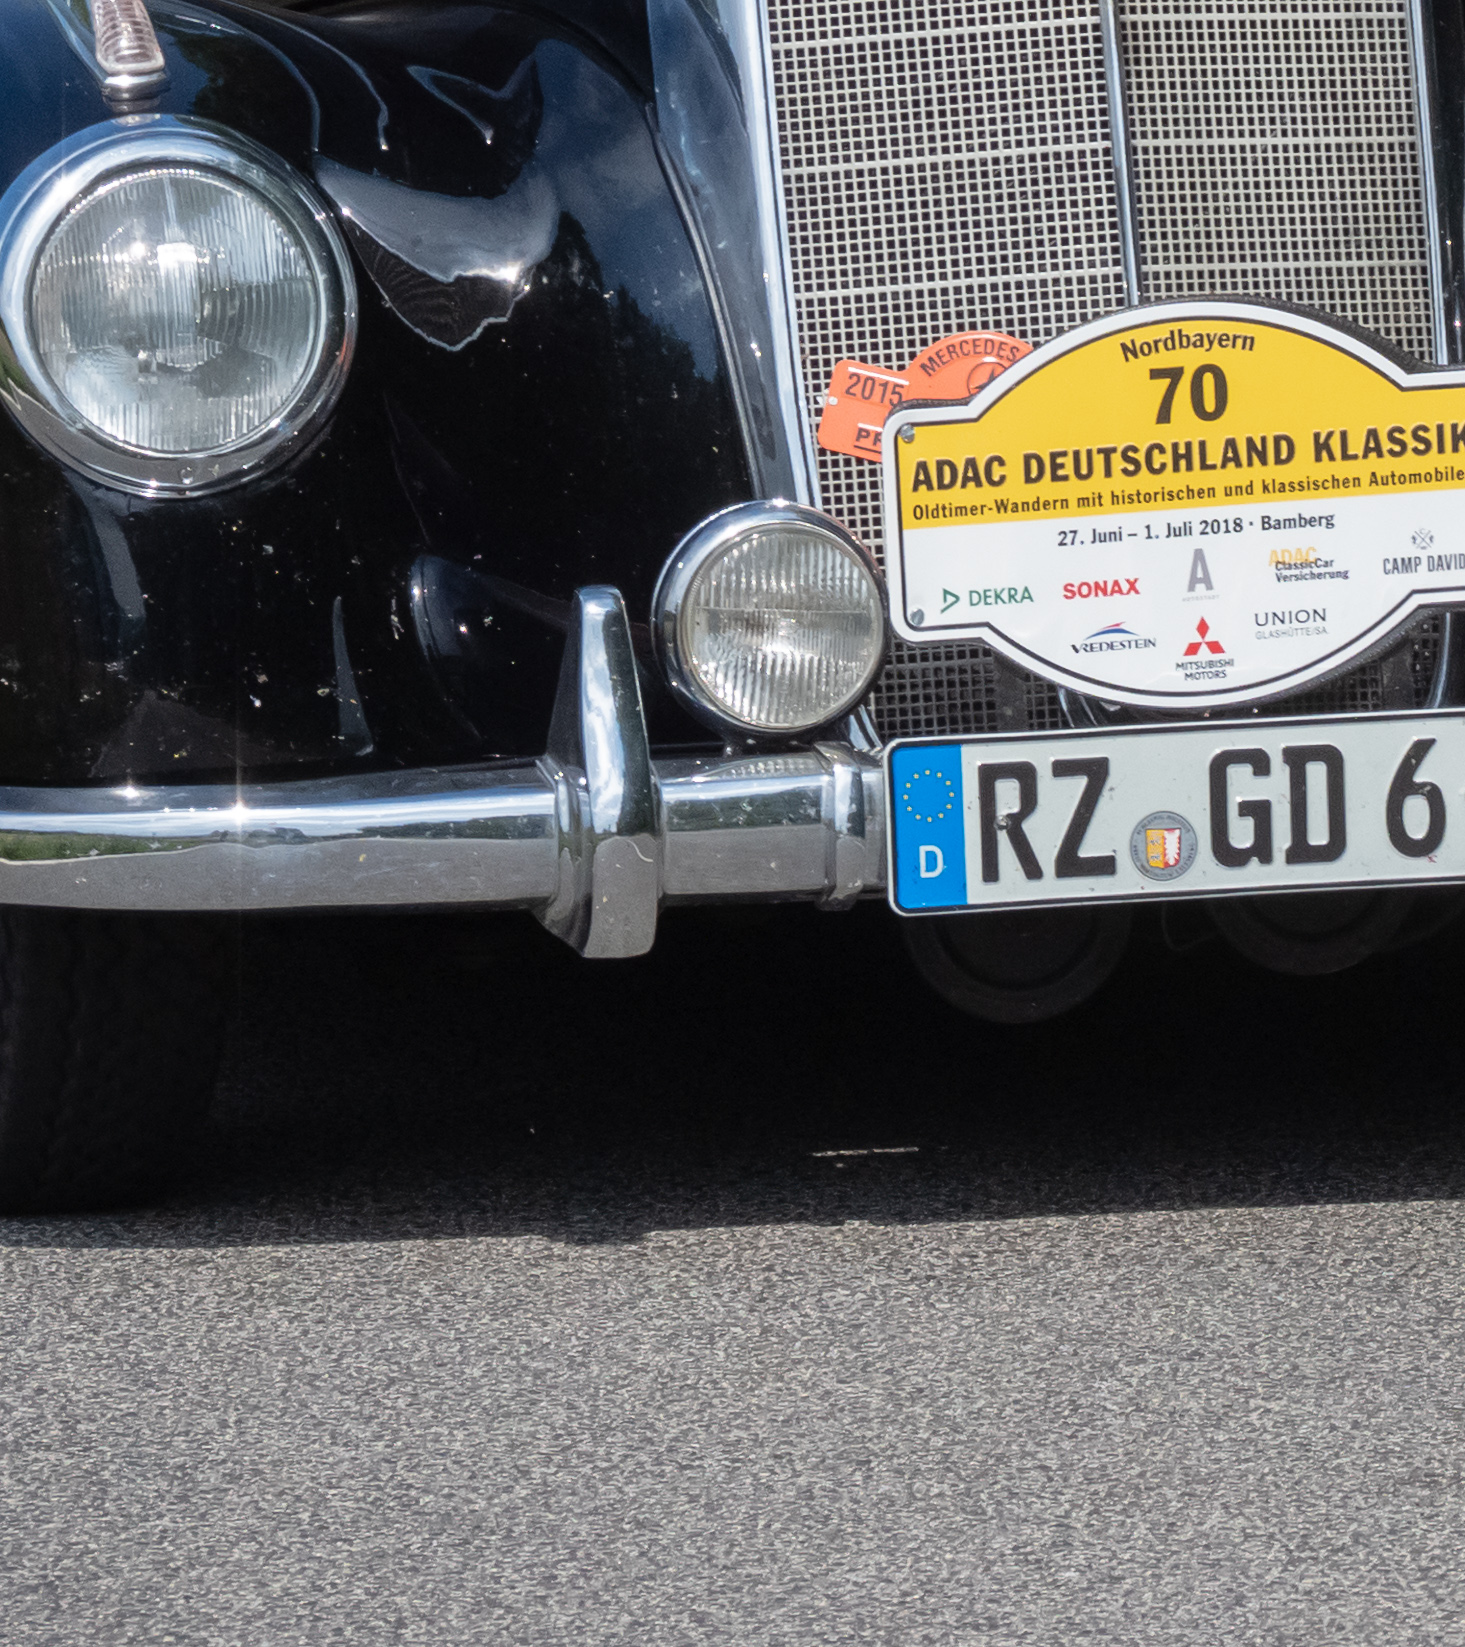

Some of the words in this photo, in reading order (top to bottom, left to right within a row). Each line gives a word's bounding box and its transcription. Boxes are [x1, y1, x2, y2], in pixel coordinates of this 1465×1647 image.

[919, 337, 1021, 378] MERCEDES
[1120, 328, 1255, 362] Nordbayern
[844, 373, 905, 408] 2015
[1149, 363, 1228, 424] 70
[912, 454, 1007, 492] ADAC
[1023, 433, 1296, 485] DEUTSCHLAND
[913, 497, 1069, 520] Oldtimer-Wandern
[1077, 491, 1104, 508] mit
[1111, 481, 1216, 506] historischen
[1224, 480, 1254, 497] und
[1262, 474, 1361, 494] klassischen
[1057, 530, 1085, 546] 27.
[1090, 526, 1123, 544] Juni
[1144, 524, 1160, 540] 1.
[1165, 521, 1193, 539] Juli
[1199, 517, 1244, 536] 2018
[1261, 512, 1335, 531] Bamberg
[1187, 548, 1214, 592] A
[1268, 546, 1318, 566] ADAC
[1275, 558, 1335, 572] ClassicCar
[1383, 555, 1420, 575] CAMP
[1062, 577, 1141, 600] SONAX
[1275, 569, 1350, 583] Versicherung
[969, 586, 1034, 607] DEKRA
[1254, 608, 1327, 627] UNION
[1070, 637, 1157, 654] VREDESTEIN
[1175, 658, 1235, 672] MITSUBISHI
[1184, 669, 1228, 681] MOTORS
[977, 756, 1117, 884] RZ
[1209, 743, 1347, 869] GD
[919, 846, 944, 879] D
